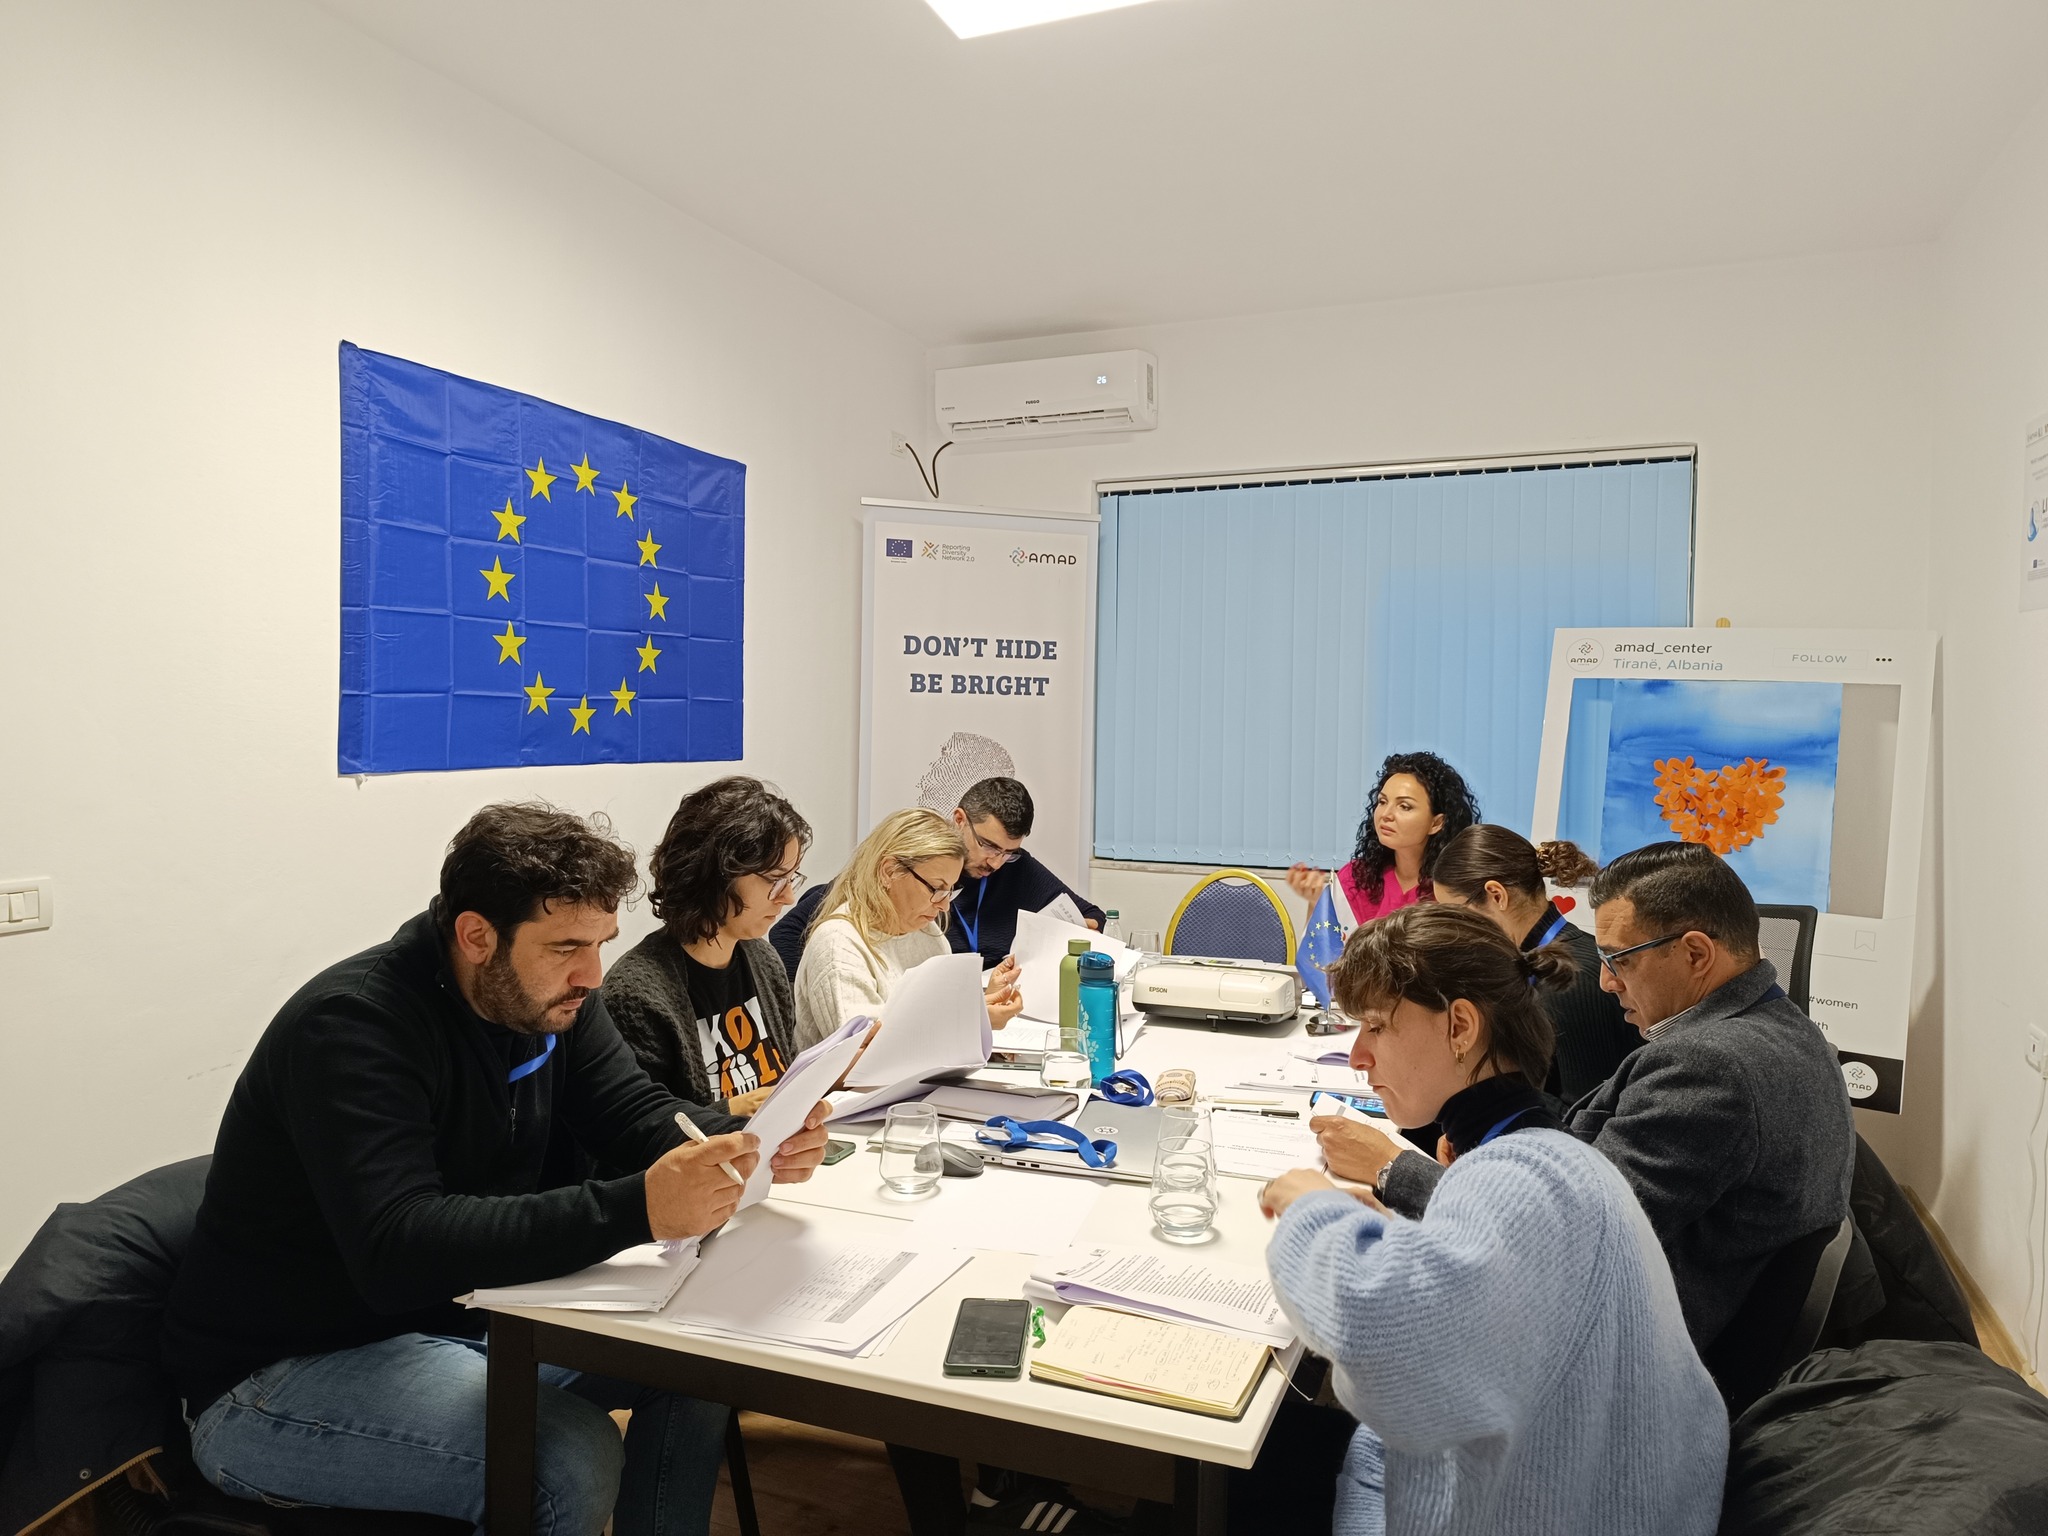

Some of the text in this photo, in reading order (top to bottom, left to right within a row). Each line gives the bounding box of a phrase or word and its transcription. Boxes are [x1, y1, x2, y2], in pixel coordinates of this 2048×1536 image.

[1096, 375, 1107, 385] 26
[942, 543, 971, 552] Reporting
[942, 549, 967, 557] Diversity
[1028, 552, 1077, 566] AMAD
[995, 638, 1058, 660] HIDE
[1614, 642, 1713, 655] amad_center
[1791, 653, 1848, 664] FOLLOW
[1613, 658, 1724, 672] Tiranë, Albania
[909, 673, 1050, 697] BE BRIGHT
[1809, 995, 1858, 1009] #women
[1814, 1020, 1829, 1030] th
[1847, 1082, 1872, 1091] MAD
